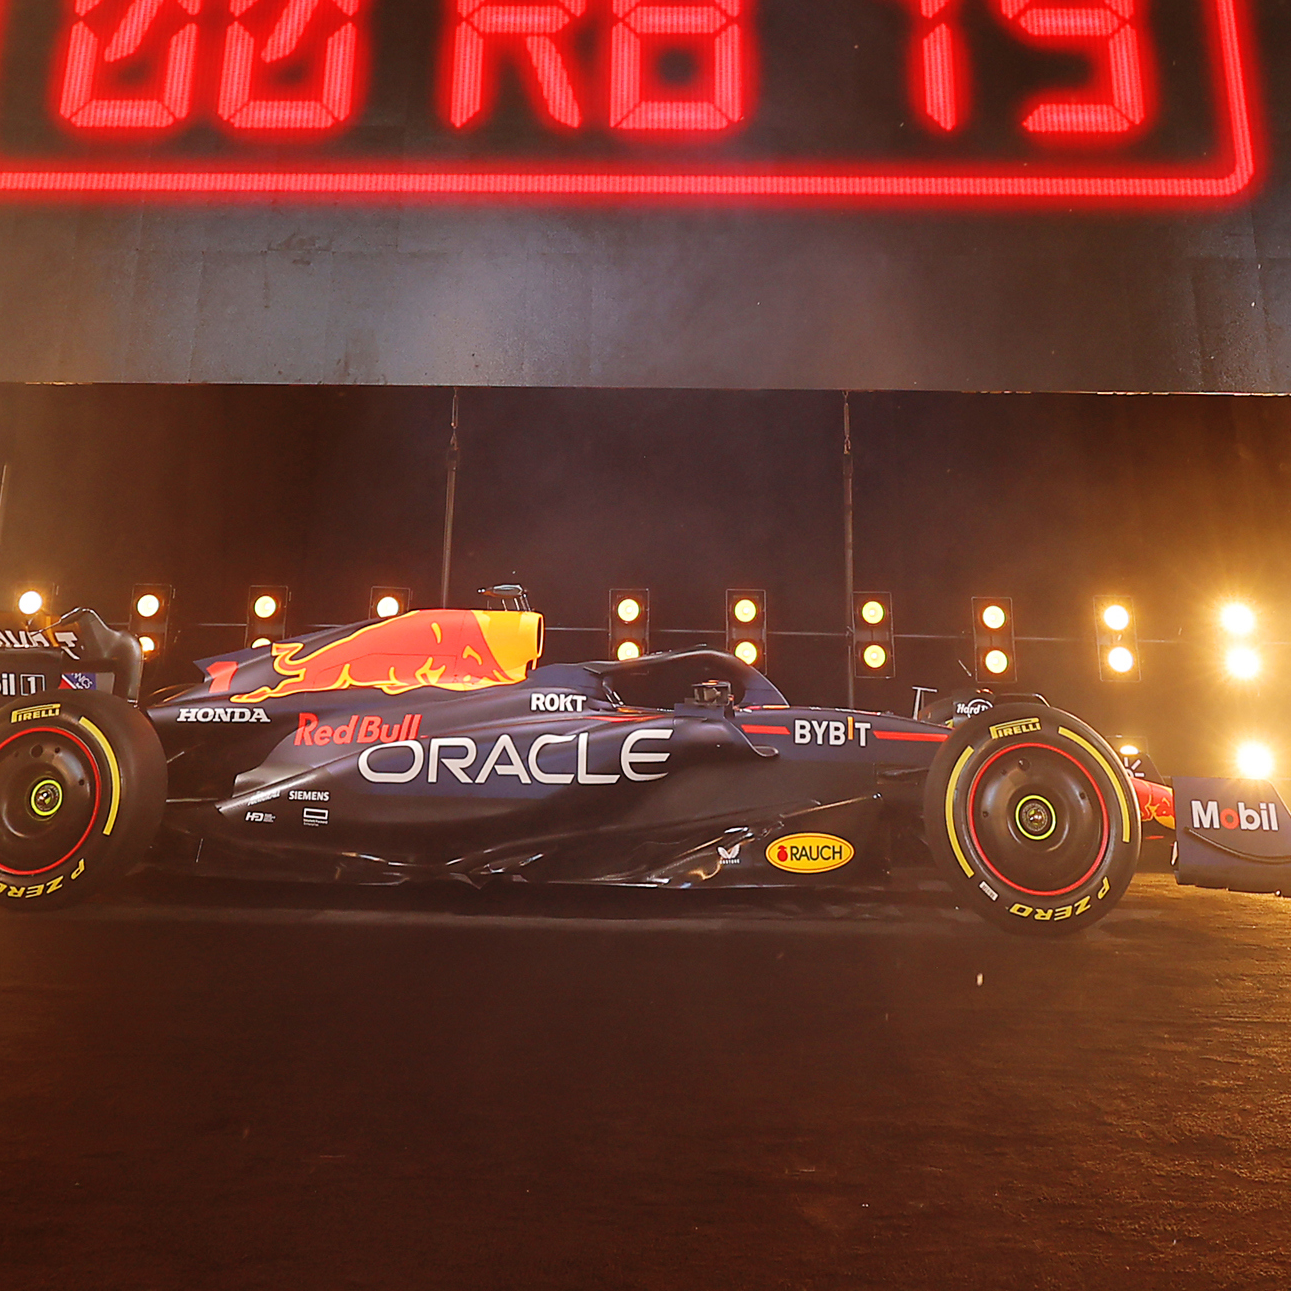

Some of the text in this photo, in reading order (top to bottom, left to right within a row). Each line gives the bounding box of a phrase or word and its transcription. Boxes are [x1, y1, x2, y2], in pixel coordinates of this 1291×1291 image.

[11, 703, 61, 723] PIRELLI
[531, 693, 587, 712] ROKT
[176, 708, 271, 723] HONDA
[293, 712, 423, 746] Red Bull
[794, 716, 871, 748] BYBIT
[989, 717, 1042, 740] PIRELLI
[357, 728, 674, 785] ORACLE
[288, 790, 330, 801] SIEMENS
[1190, 800, 1279, 831] Mobil
[790, 845, 842, 861] RAUCH
[70, 858, 85, 880] P
[1009, 876, 1111, 921] P ZERO
